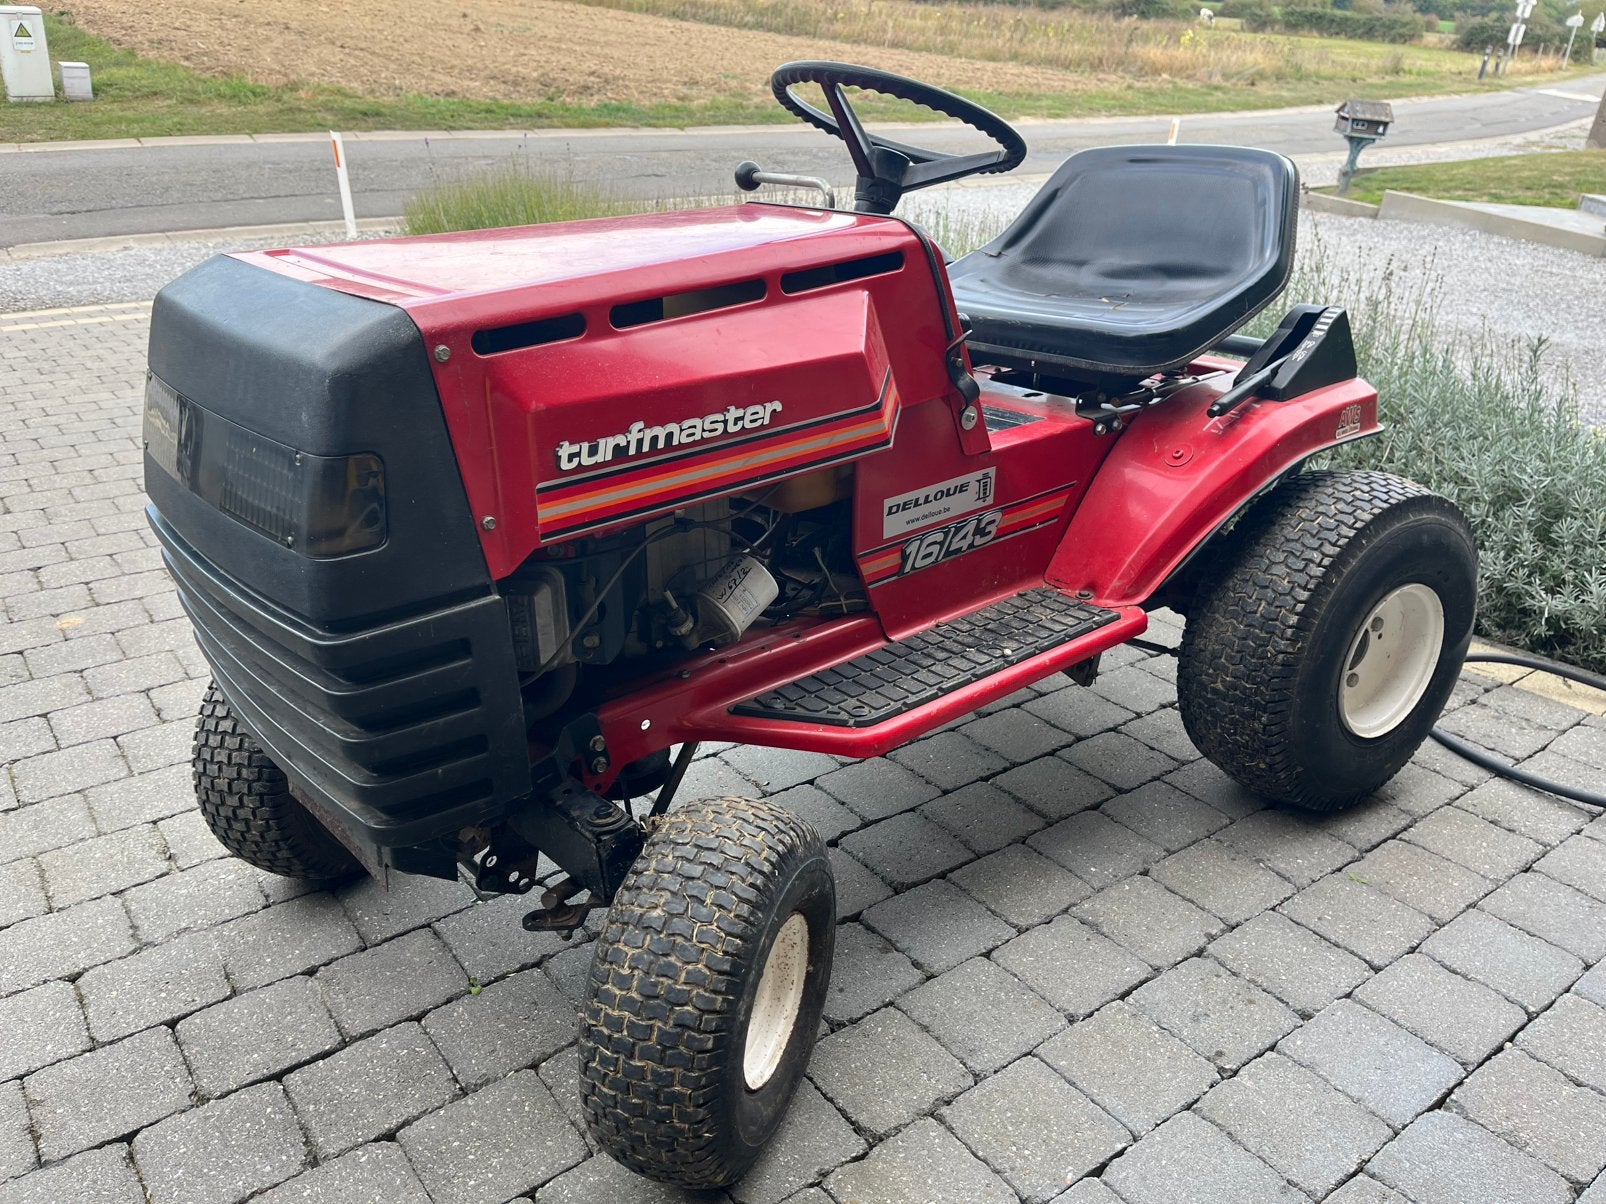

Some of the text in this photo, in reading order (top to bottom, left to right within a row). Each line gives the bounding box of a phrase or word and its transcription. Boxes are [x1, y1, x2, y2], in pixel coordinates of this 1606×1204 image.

[555, 400, 783, 471] turfmaster
[886, 481, 971, 517] DELLOUE
[905, 506, 951, 525] www.delloue.be
[902, 509, 1003, 574] 16/43
